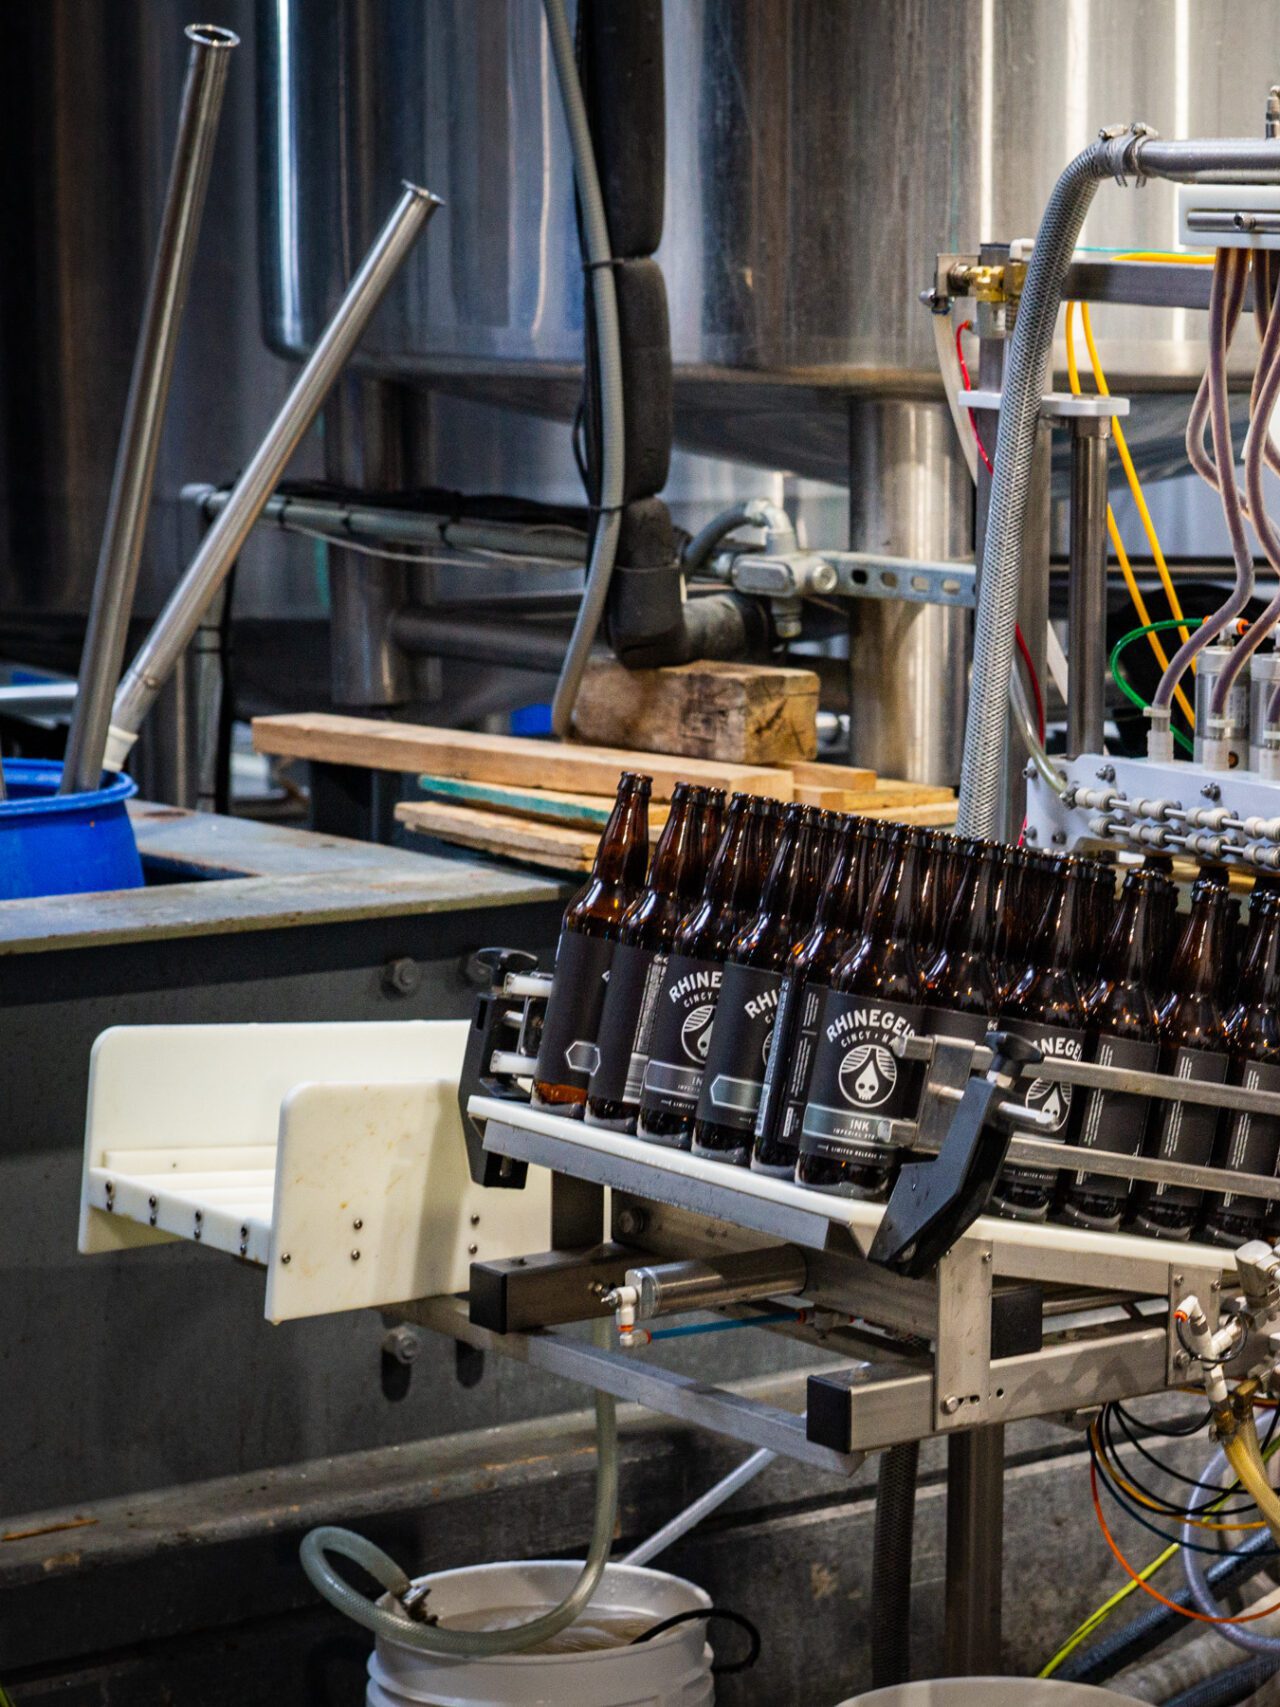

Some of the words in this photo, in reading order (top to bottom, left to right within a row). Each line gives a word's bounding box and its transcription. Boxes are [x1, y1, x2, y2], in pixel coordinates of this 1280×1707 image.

[683, 991, 712, 1008] CINCY
[841, 1030, 871, 1048] CINCY
[850, 1118, 869, 1131] INK
